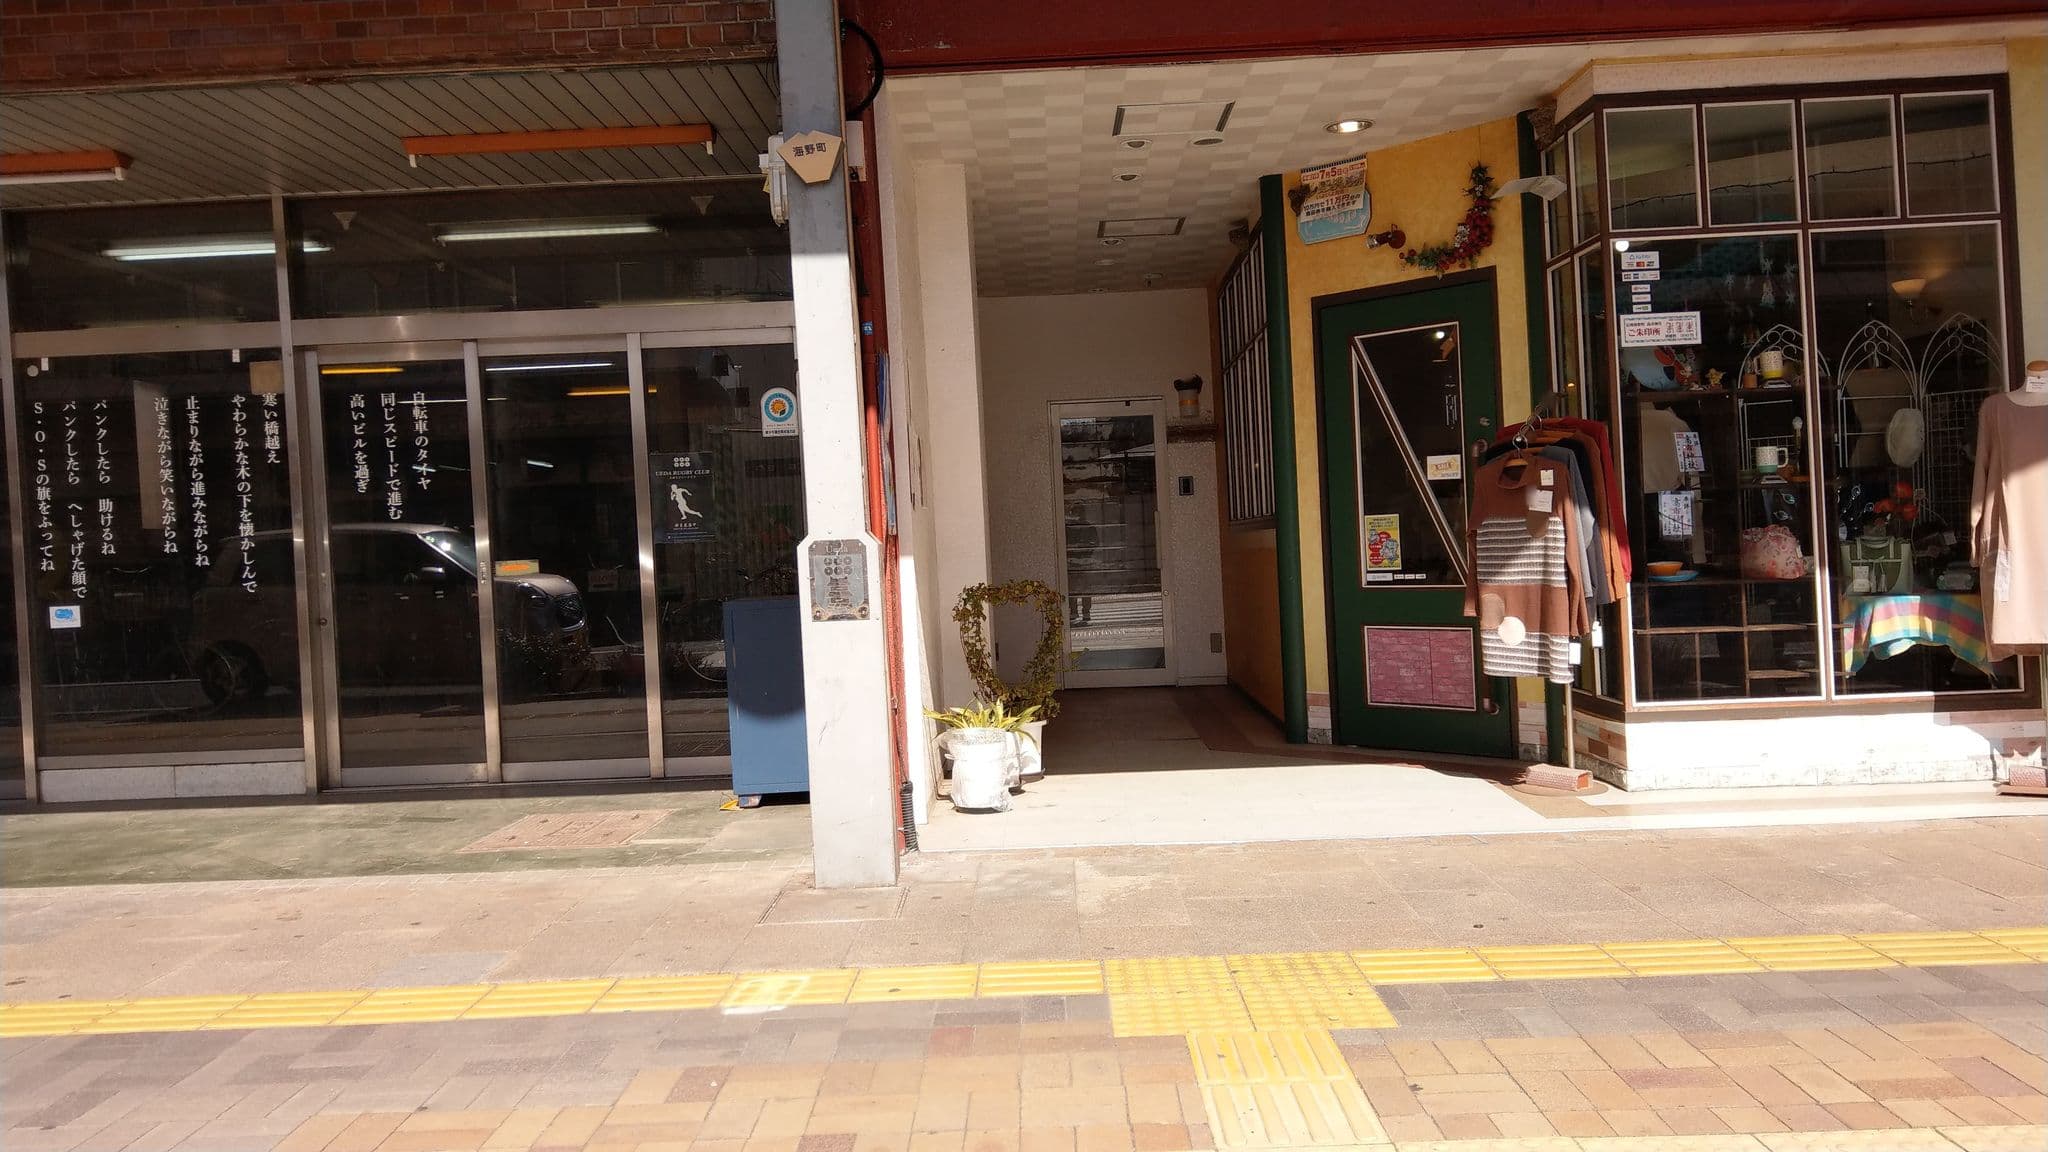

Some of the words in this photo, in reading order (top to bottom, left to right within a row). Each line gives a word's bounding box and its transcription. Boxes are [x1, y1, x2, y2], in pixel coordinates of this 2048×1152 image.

[792, 142, 827, 158] 海野町
[62, 400, 80, 486] パンクしたら
[93, 400, 111, 485] パンクしたら
[154, 397, 179, 554] 泣きながら笑いながらね
[262, 392, 281, 465] 寒い橋越え
[349, 393, 370, 493] 高いビルを過ぎ
[380, 392, 403, 520] 同じスピードで進む
[412, 391, 432, 491] 自転車のタイヤ
[99, 498, 117, 556] 助けるね
[185, 395, 210, 567] 止まりながら進みながらね
[231, 395, 257, 593] やわらかな木の下を懐かしんで
[67, 502, 88, 599] へしゃげた顔で
